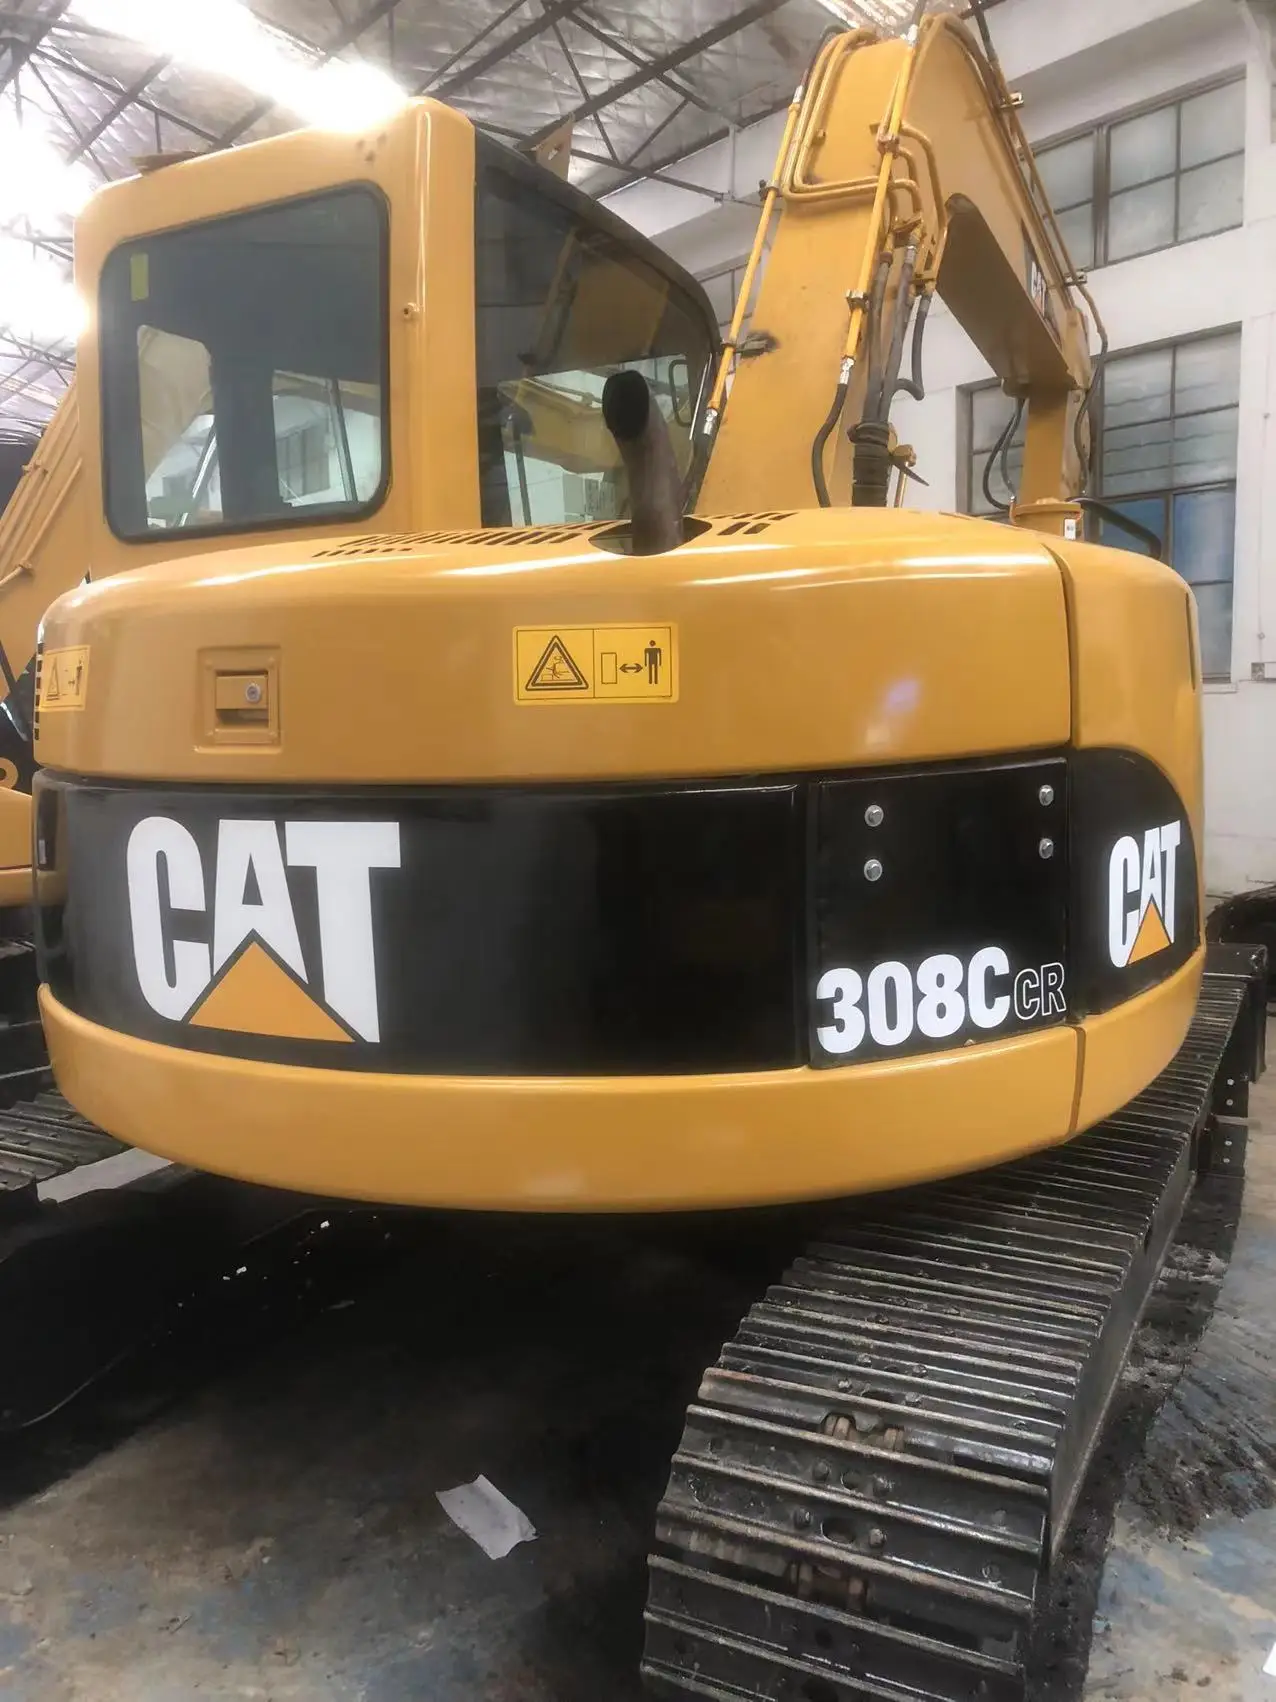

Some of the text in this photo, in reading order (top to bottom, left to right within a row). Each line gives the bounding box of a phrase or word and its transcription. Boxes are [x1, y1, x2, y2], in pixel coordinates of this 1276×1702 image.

[127, 816, 401, 1043] CAT
[1109, 820, 1180, 968] CAT
[816, 947, 1067, 1053] 308C CR
